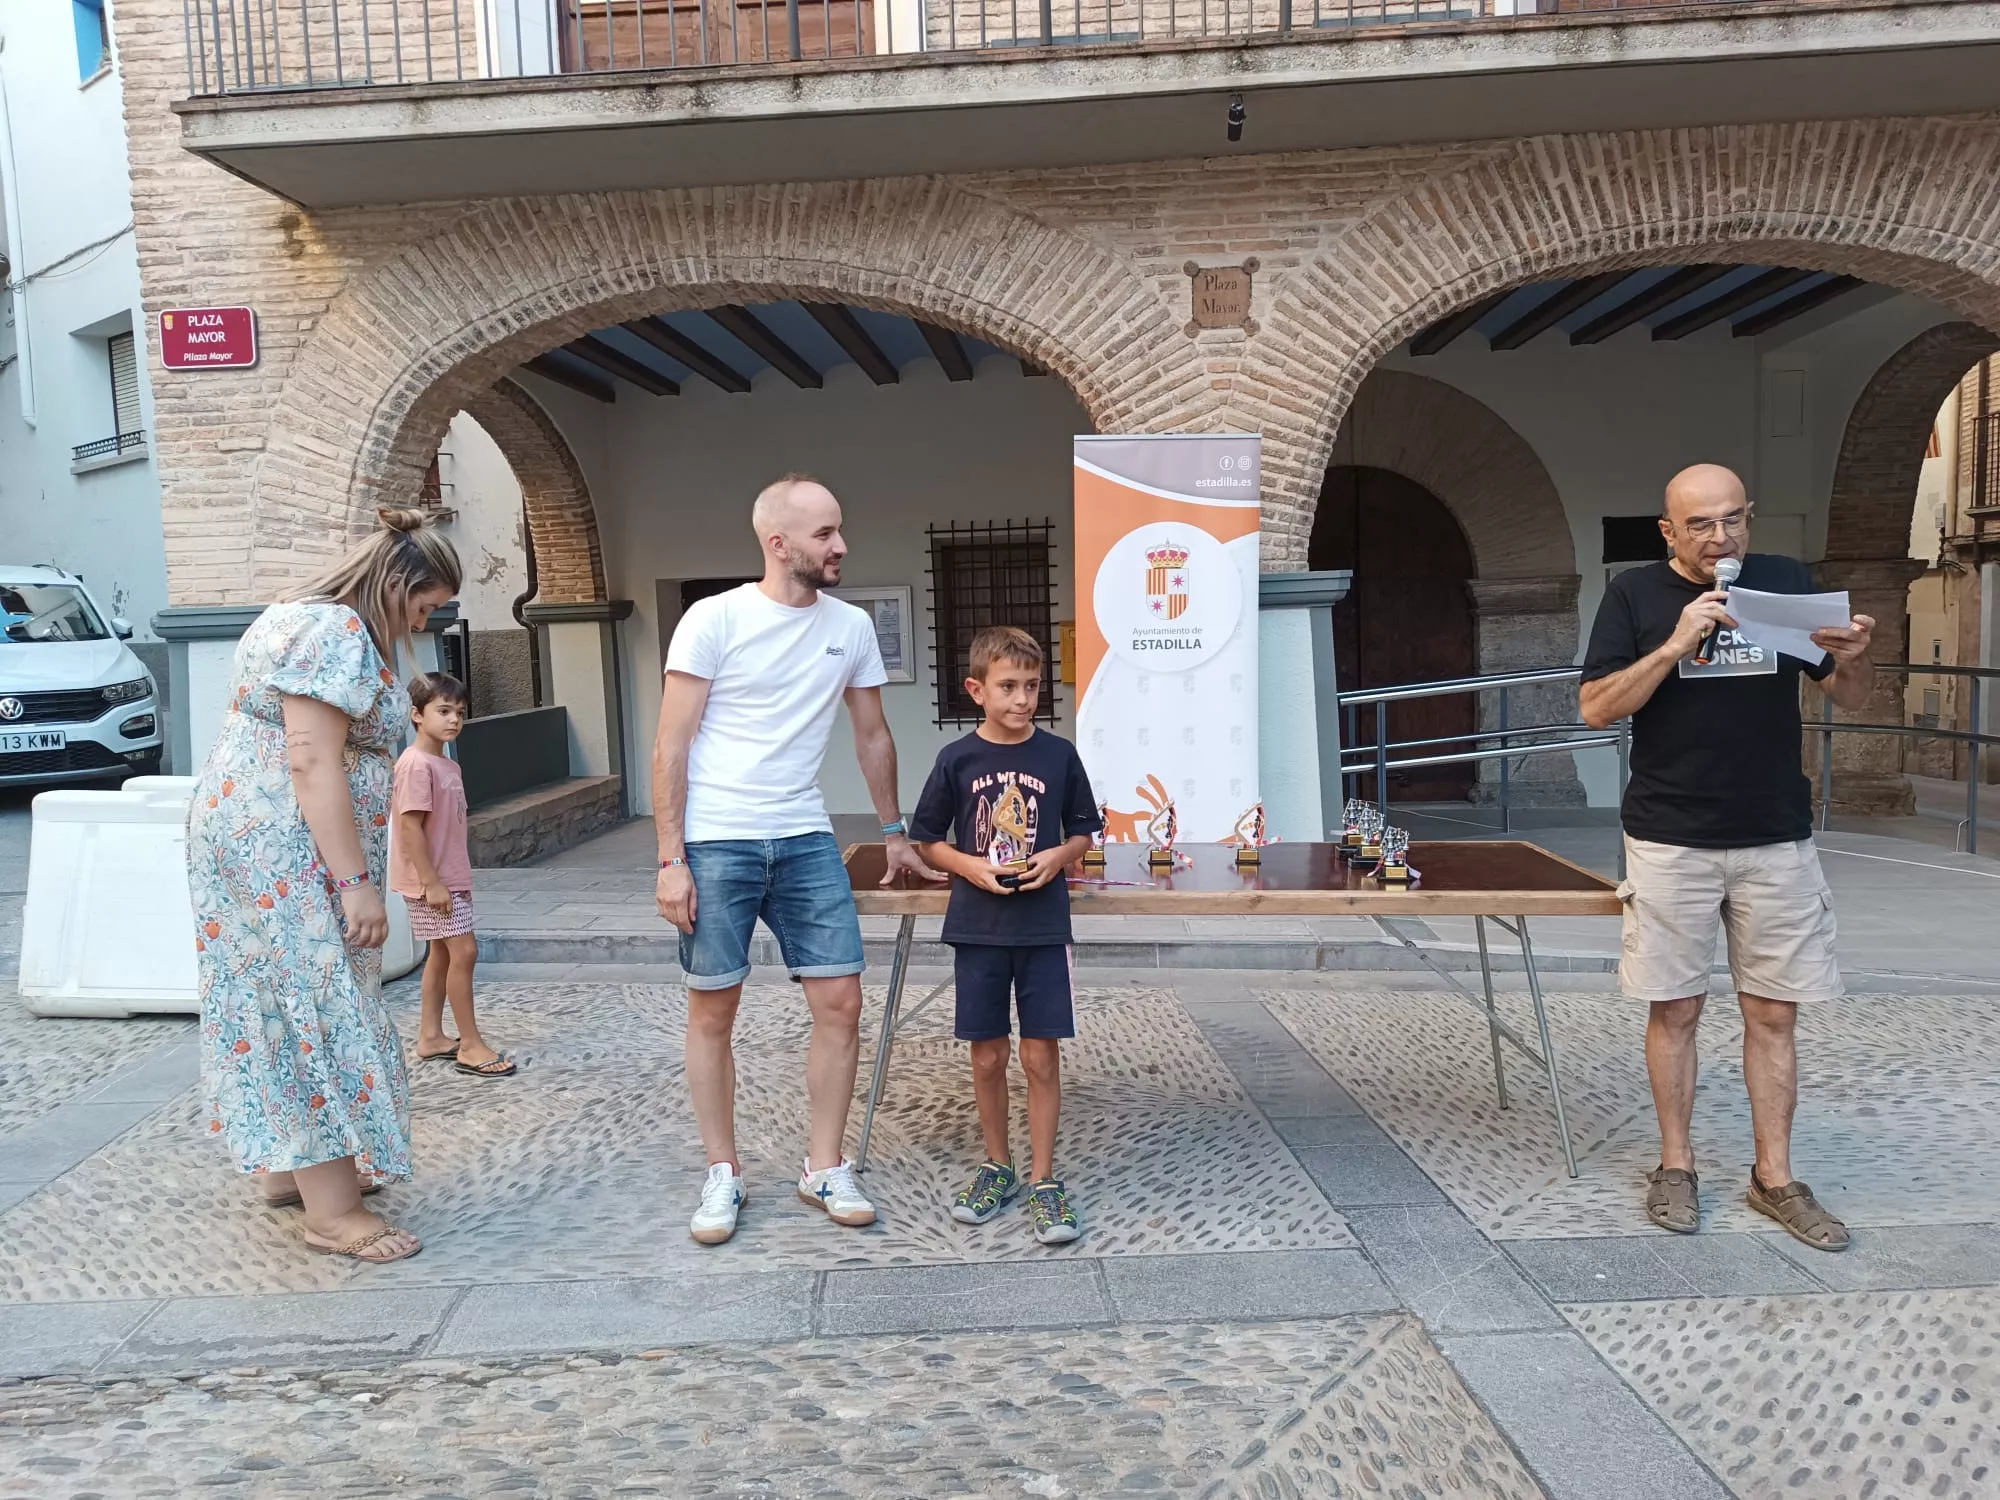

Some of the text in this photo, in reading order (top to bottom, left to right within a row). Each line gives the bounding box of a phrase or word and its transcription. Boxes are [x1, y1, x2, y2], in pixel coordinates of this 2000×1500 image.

[1203, 274, 1238, 292] Plaza
[188, 314, 224, 327] PLAZA
[188, 331, 226, 344] MAYOR
[209, 352, 233, 362] Mayor
[1195, 476, 1252, 488] estadilla.es
[1132, 627, 1203, 637] Ayuntamiento de
[1132, 638, 1202, 650] ESTADILLA
[28, 733, 61, 749] KWM
[972, 774, 994, 794] ALL
[1018, 773, 1046, 795] NEED
